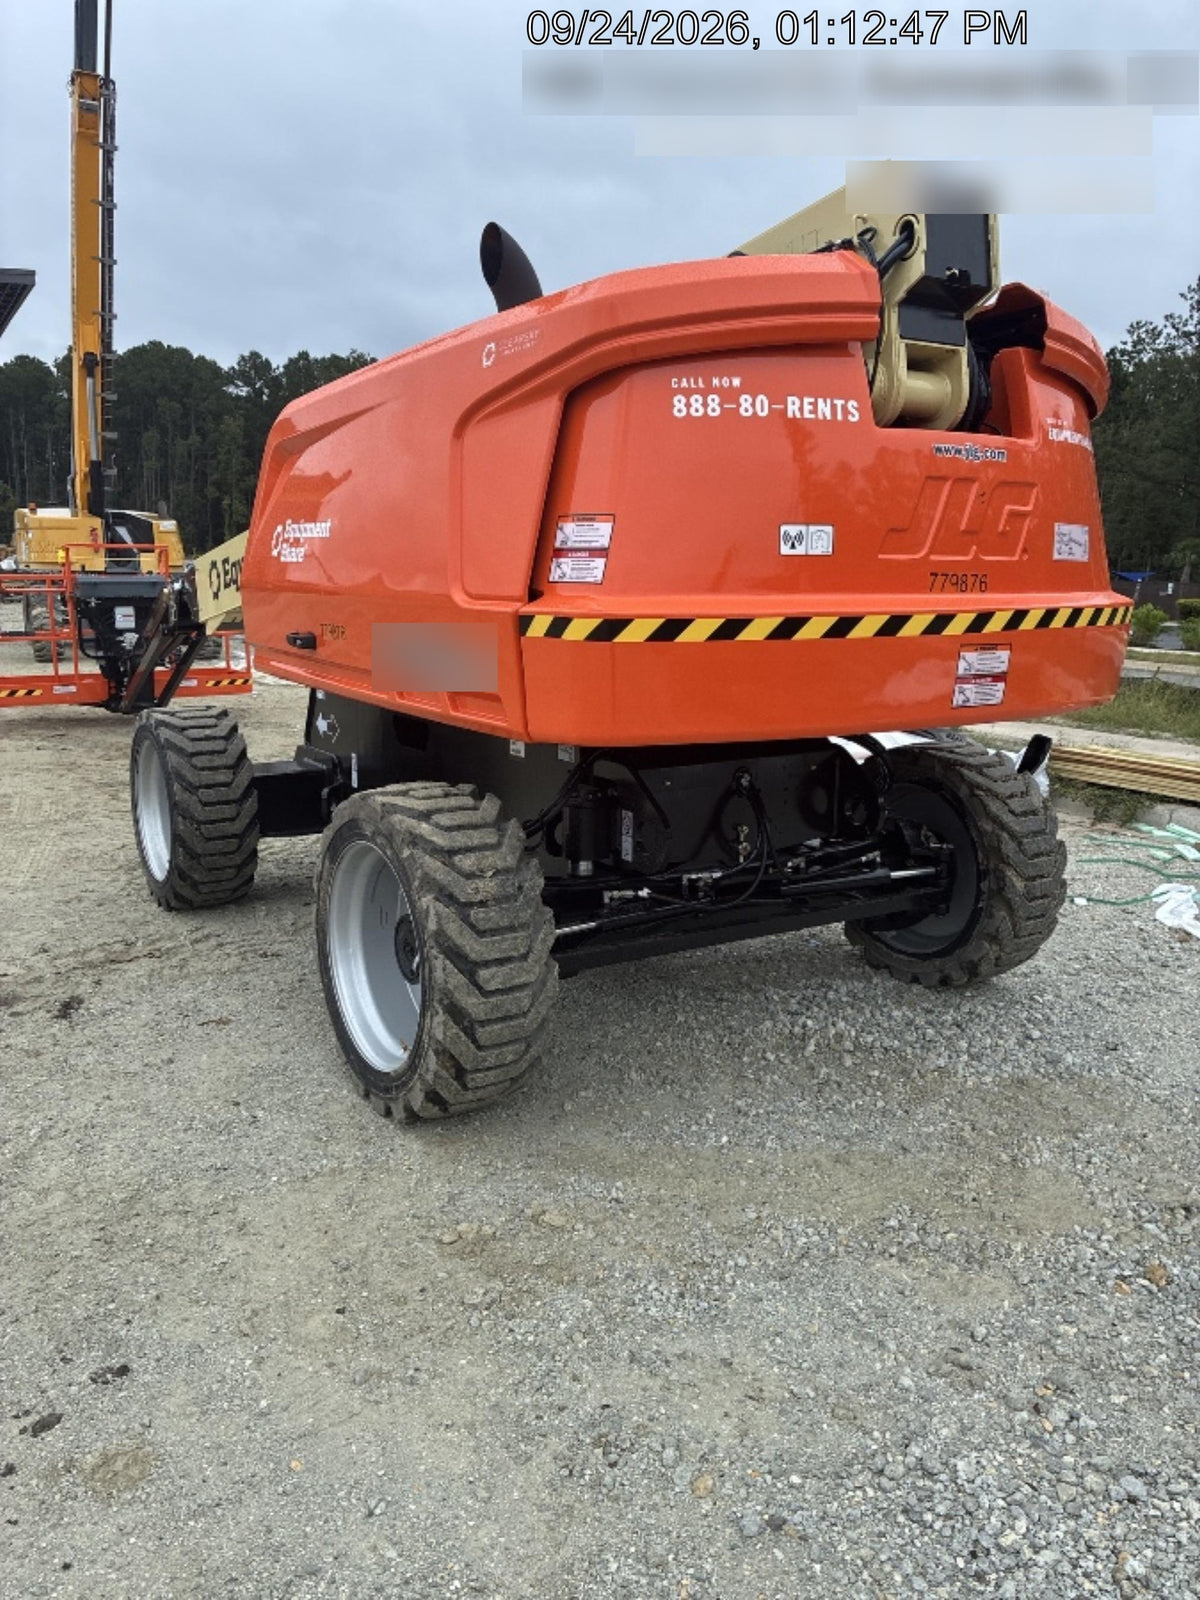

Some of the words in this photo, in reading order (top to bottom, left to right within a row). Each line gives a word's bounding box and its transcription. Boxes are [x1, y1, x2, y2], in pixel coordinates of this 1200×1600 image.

[671, 377, 705, 389] CALL
[712, 376, 742, 388] NOW
[672, 393, 861, 423] 888-80-RENTS
[932, 443, 1008, 463] www.jlg.com
[878, 475, 1039, 561] JLG
[929, 571, 989, 593] 779876
